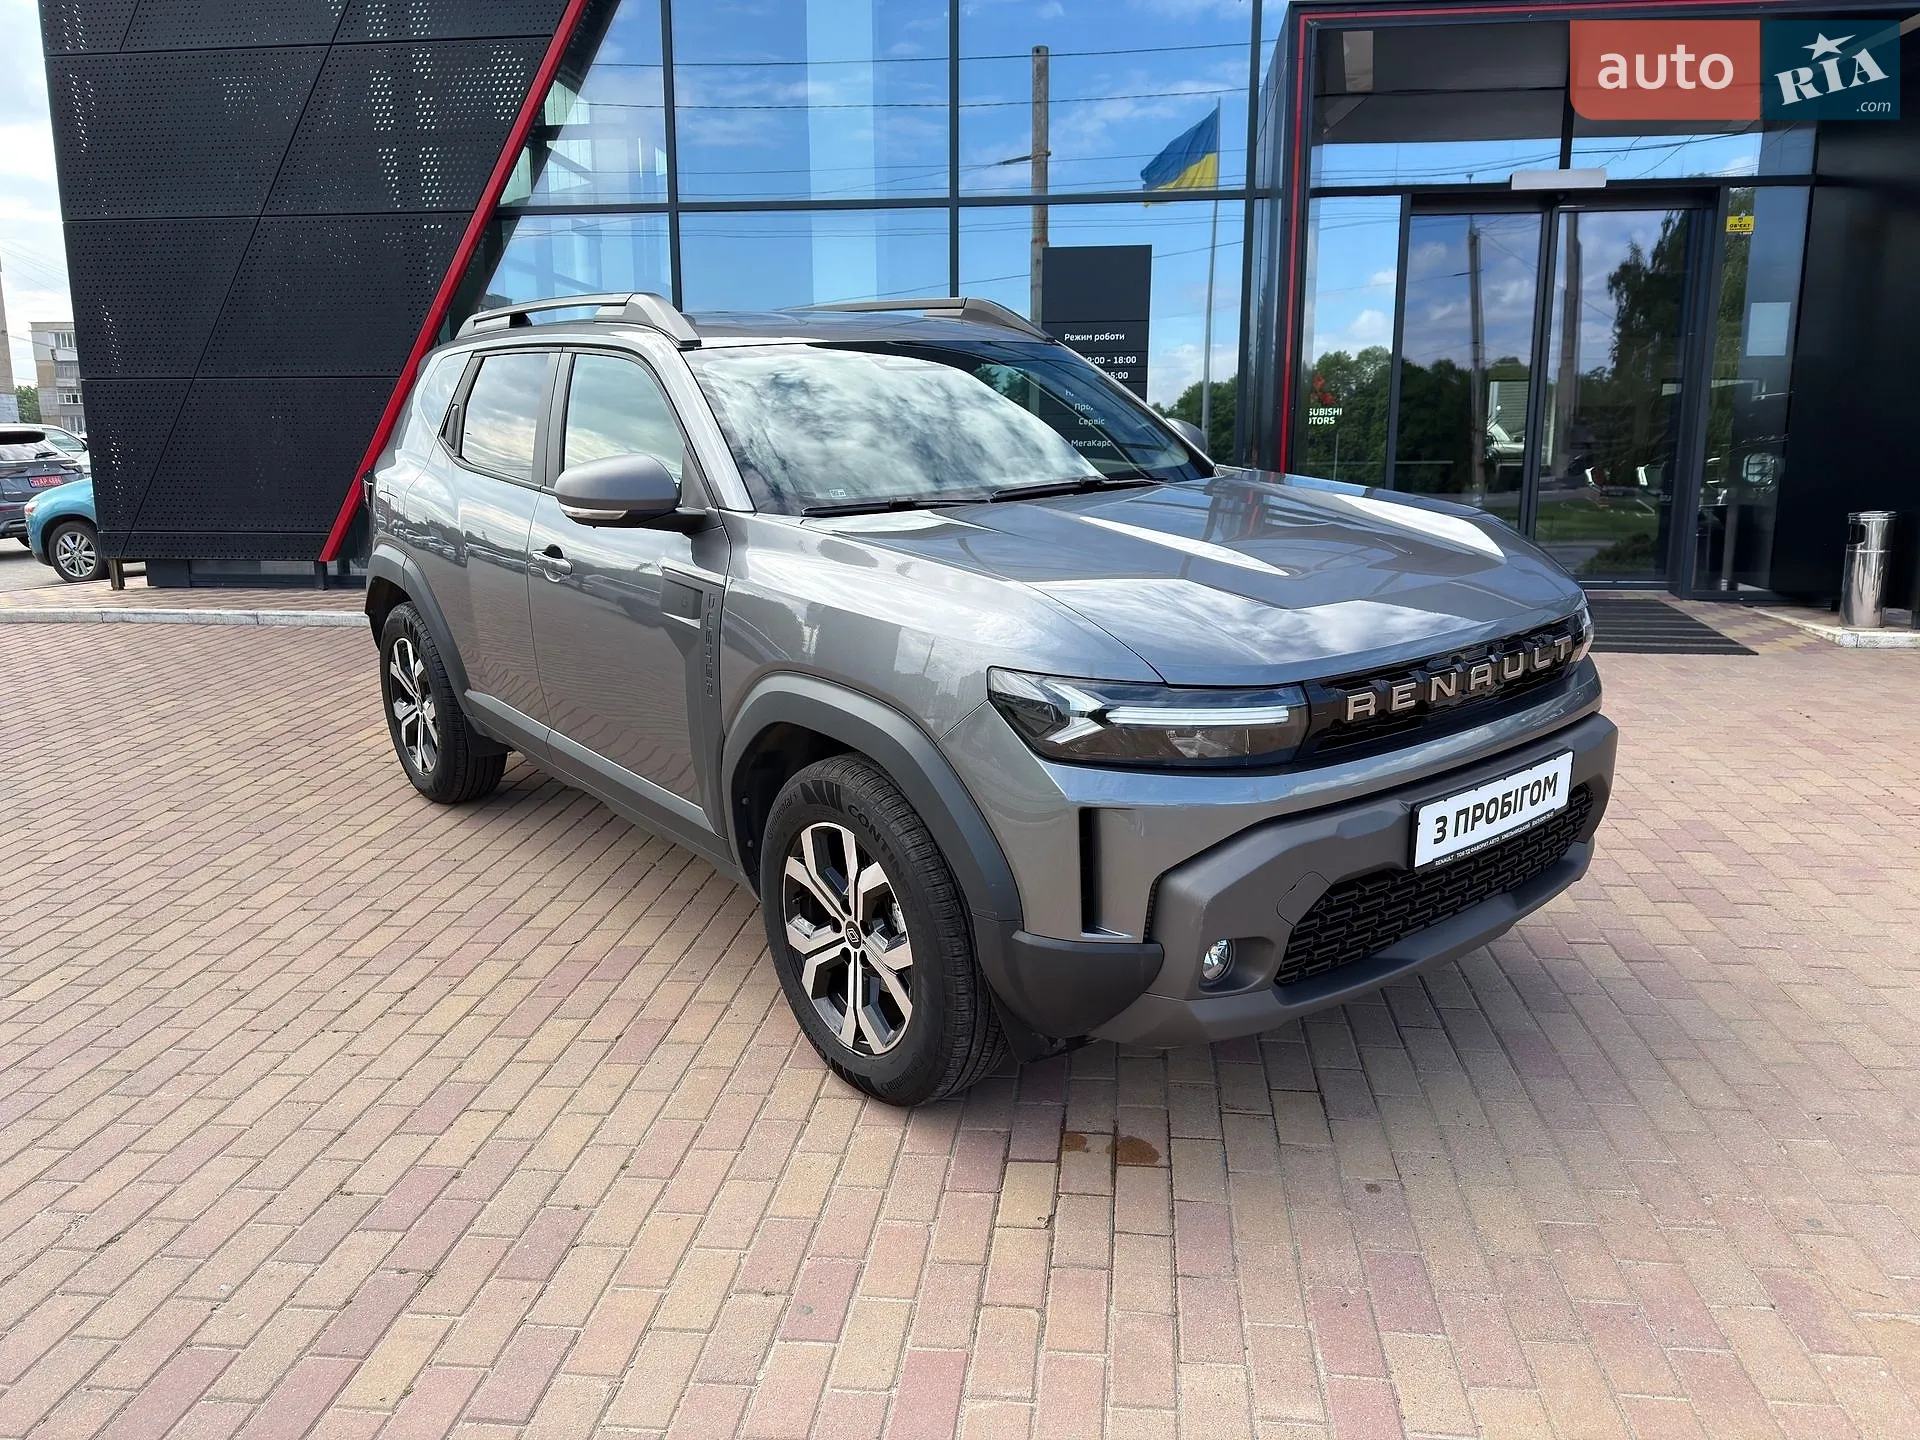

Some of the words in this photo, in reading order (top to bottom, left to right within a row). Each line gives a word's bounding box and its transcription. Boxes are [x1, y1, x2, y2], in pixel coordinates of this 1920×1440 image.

[1064, 333, 1093, 341] Режим
[1094, 332, 1126, 342] роботи
[1113, 356, 1137, 364] 18:00
[705, 592, 715, 698] DUSTER
[1347, 635, 1572, 721] RENAULT
[1453, 771, 1559, 838] ПРОБІГОМ
